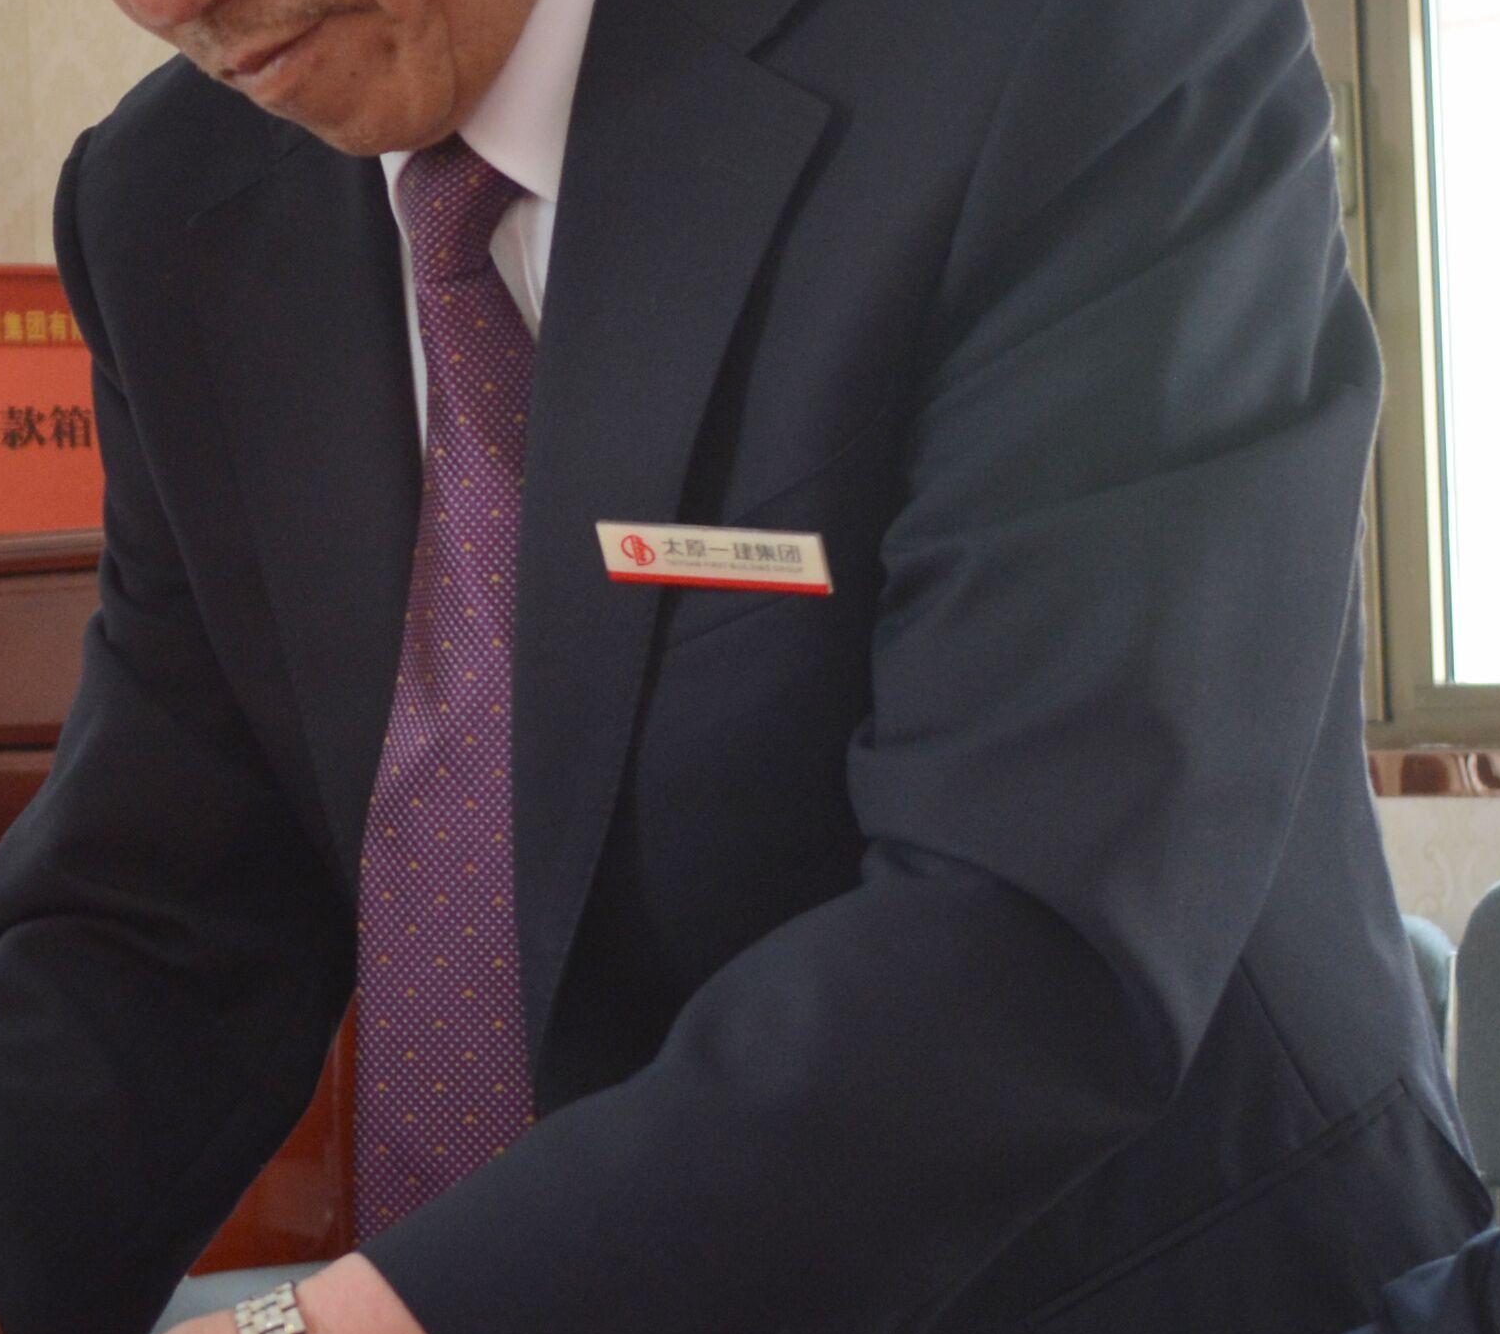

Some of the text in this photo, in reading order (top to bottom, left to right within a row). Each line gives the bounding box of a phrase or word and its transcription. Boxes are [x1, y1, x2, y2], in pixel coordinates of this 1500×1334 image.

[662, 537, 802, 563] 太原一建集团
